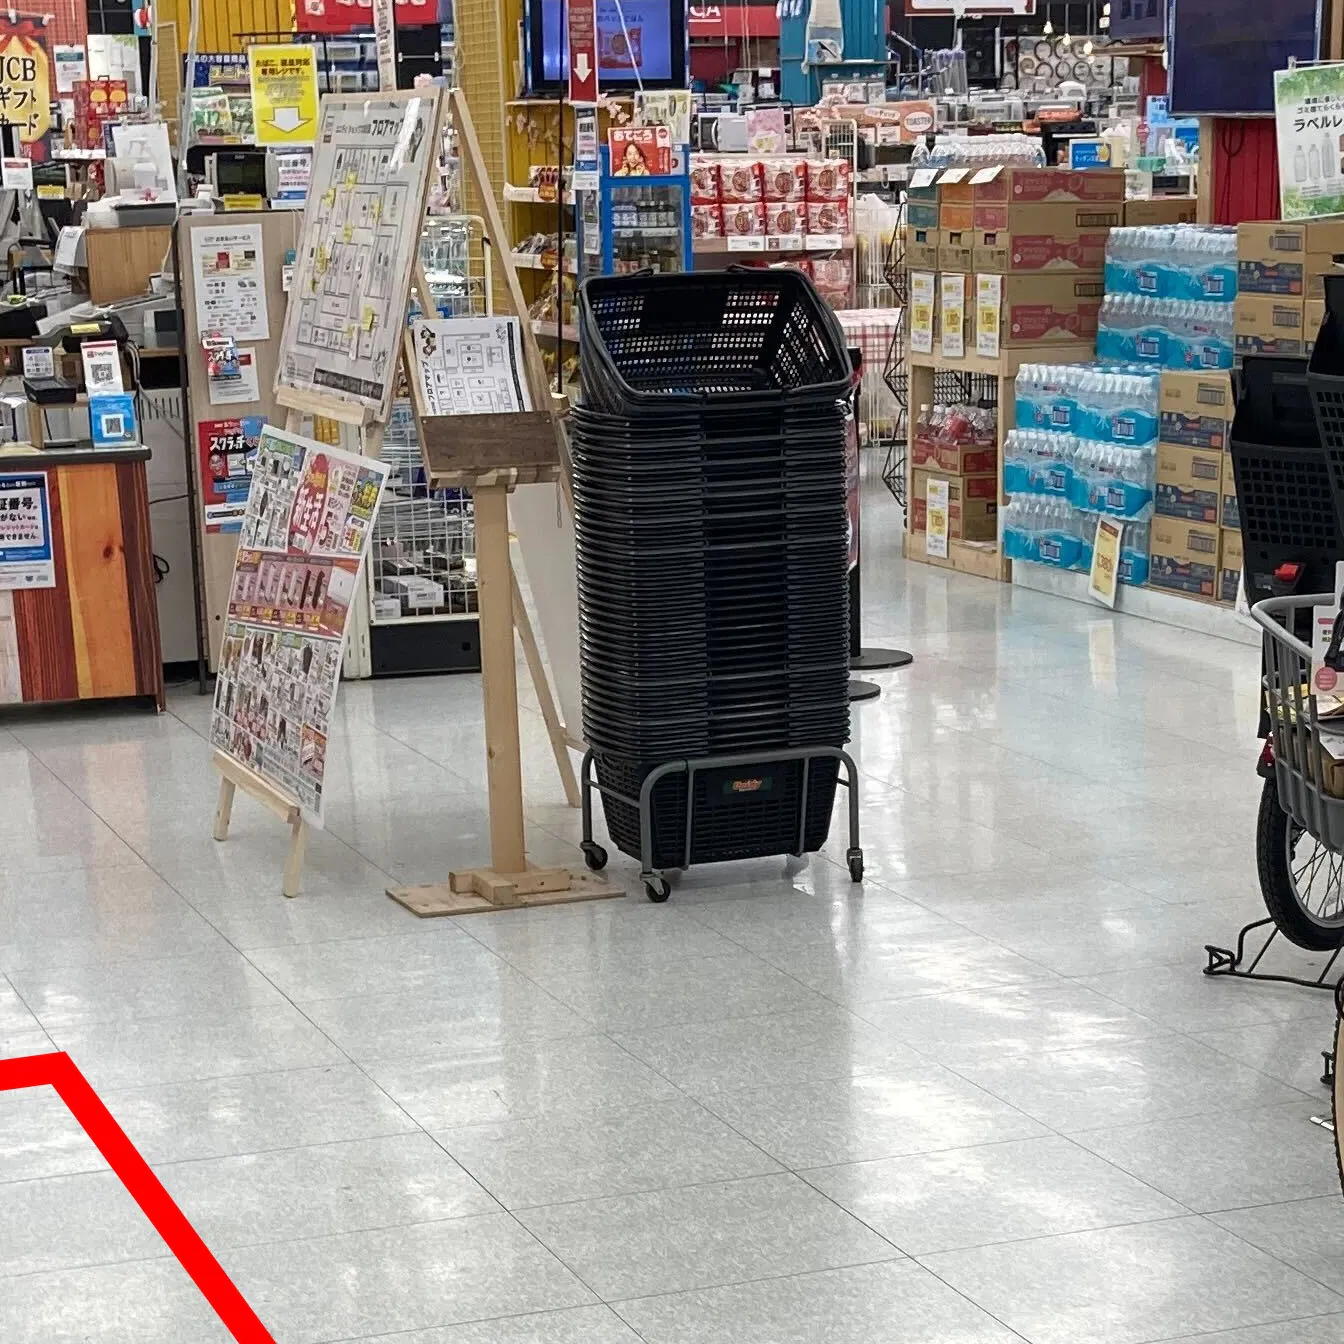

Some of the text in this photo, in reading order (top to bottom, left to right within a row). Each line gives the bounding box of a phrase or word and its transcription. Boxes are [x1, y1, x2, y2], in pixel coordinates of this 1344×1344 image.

[372, 119, 405, 136] フロアマッ
